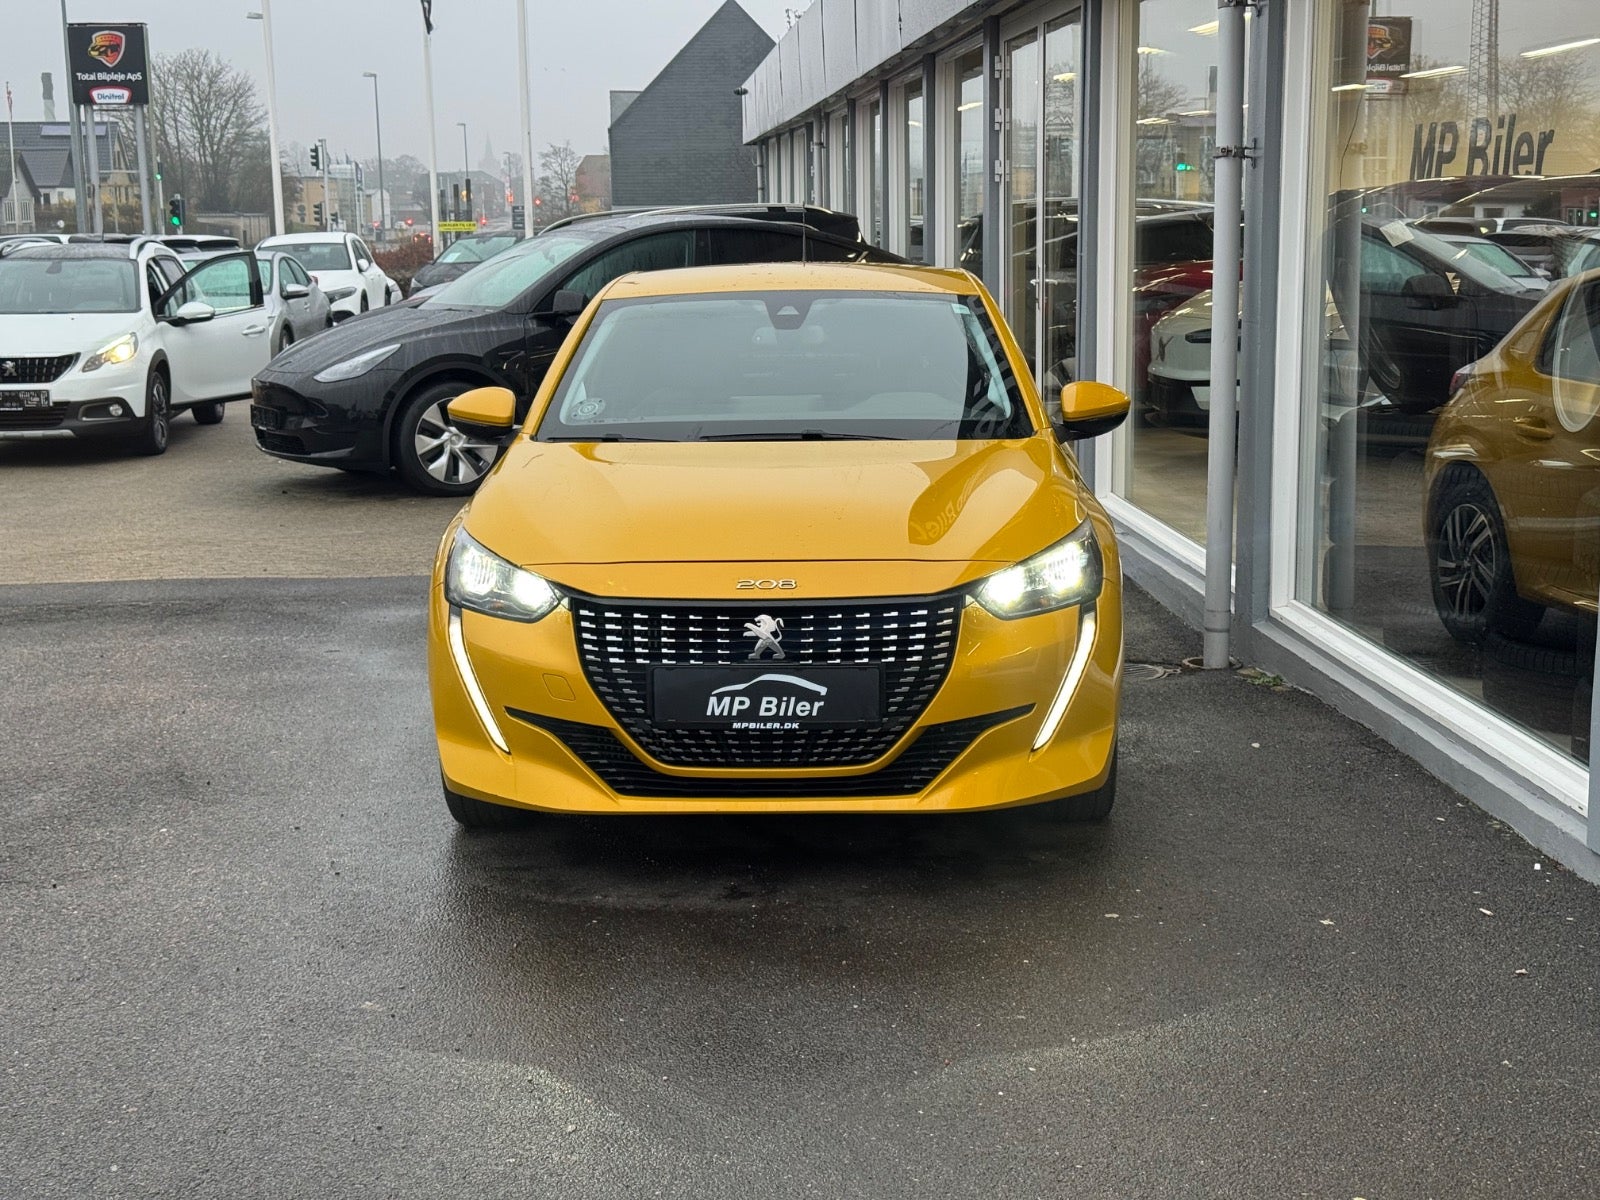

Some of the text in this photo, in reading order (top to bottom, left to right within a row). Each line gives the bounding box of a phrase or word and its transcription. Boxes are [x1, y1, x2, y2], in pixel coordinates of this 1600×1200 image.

[76, 72, 142, 82] Total Bilpleje ApS
[1410, 113, 1555, 181] MP Biler
[736, 579, 797, 589] 208
[706, 696, 825, 717] MP Biler
